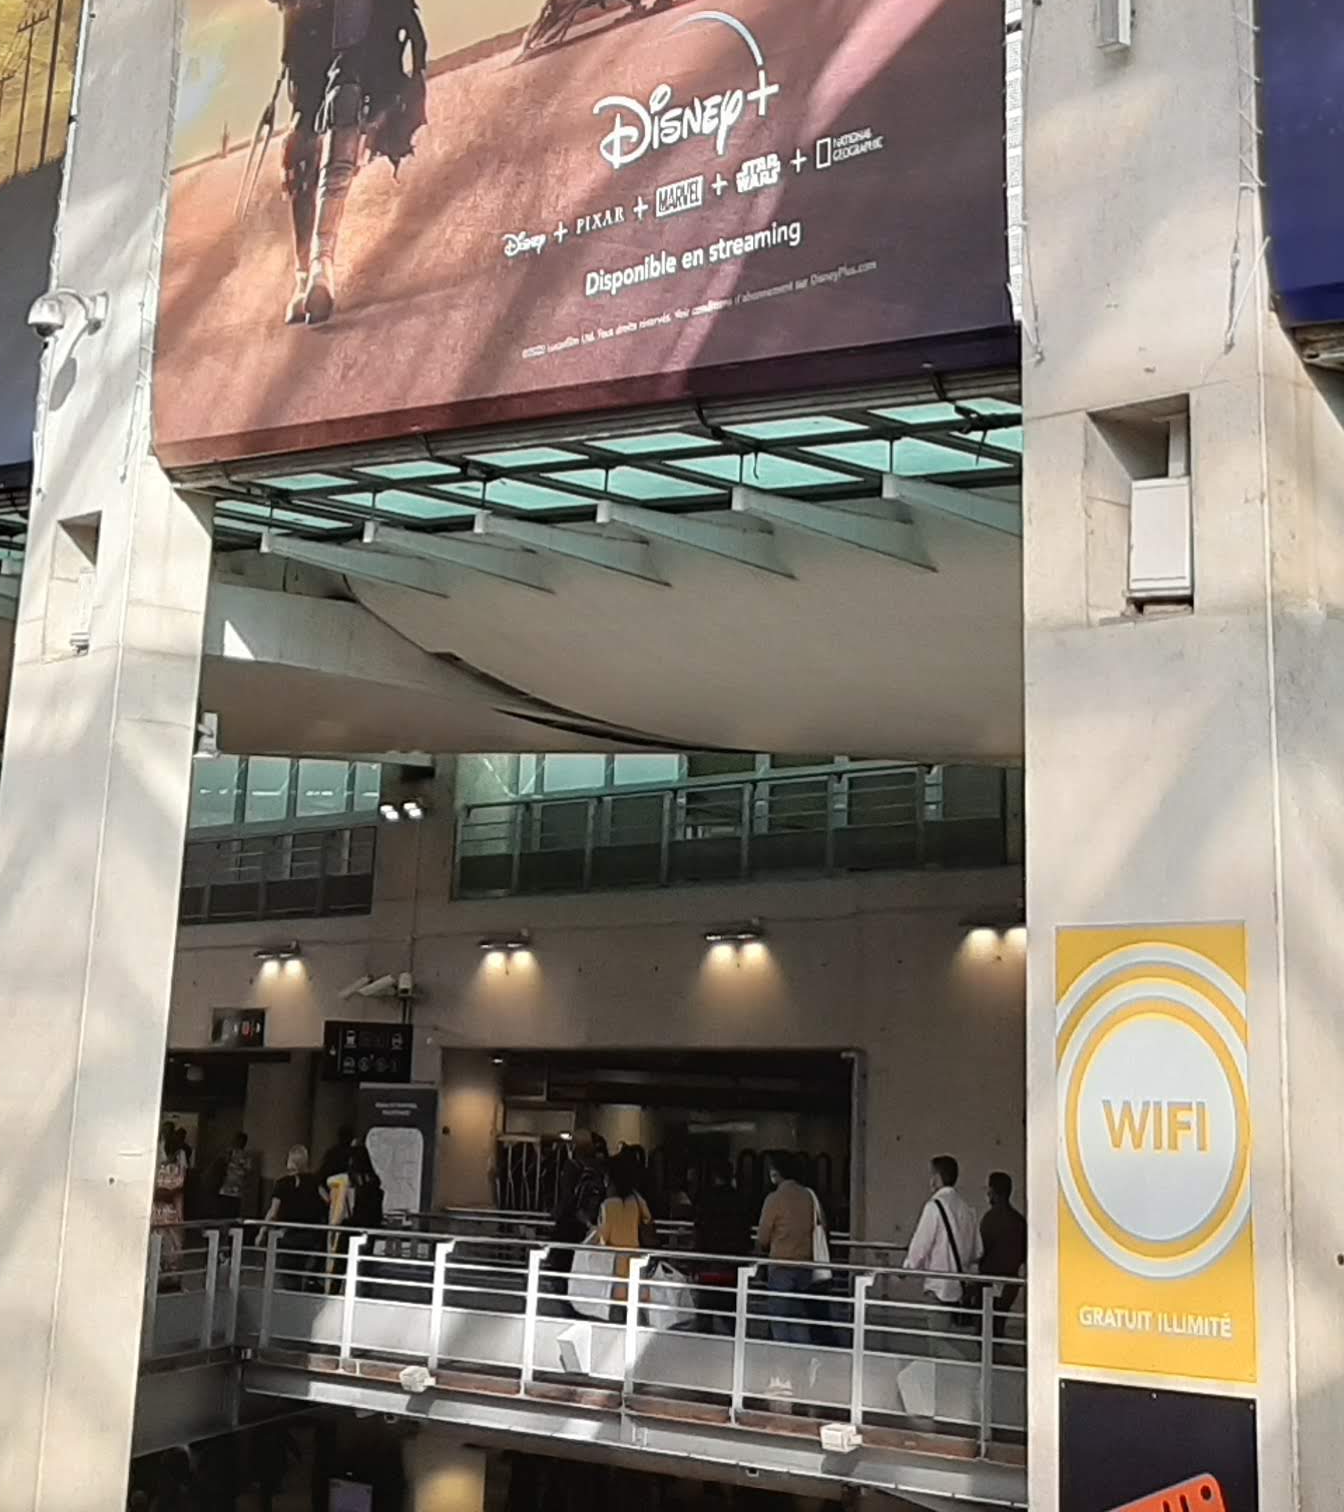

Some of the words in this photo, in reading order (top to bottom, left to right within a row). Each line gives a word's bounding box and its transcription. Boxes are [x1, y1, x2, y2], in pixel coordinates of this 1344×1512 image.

[736, 168, 781, 193] WARS
[742, 153, 781, 176] STAR
[576, 205, 625, 234] PIXAR
[658, 179, 701, 212] MARVEL
[585, 250, 677, 297] Disponible
[682, 248, 704, 270] en
[709, 222, 801, 264] streaming
[1102, 1099, 1210, 1152] WIFI
[1080, 1305, 1152, 1330] GRATUIT
[1158, 1312, 1232, 1337] ILLIMITÉ
